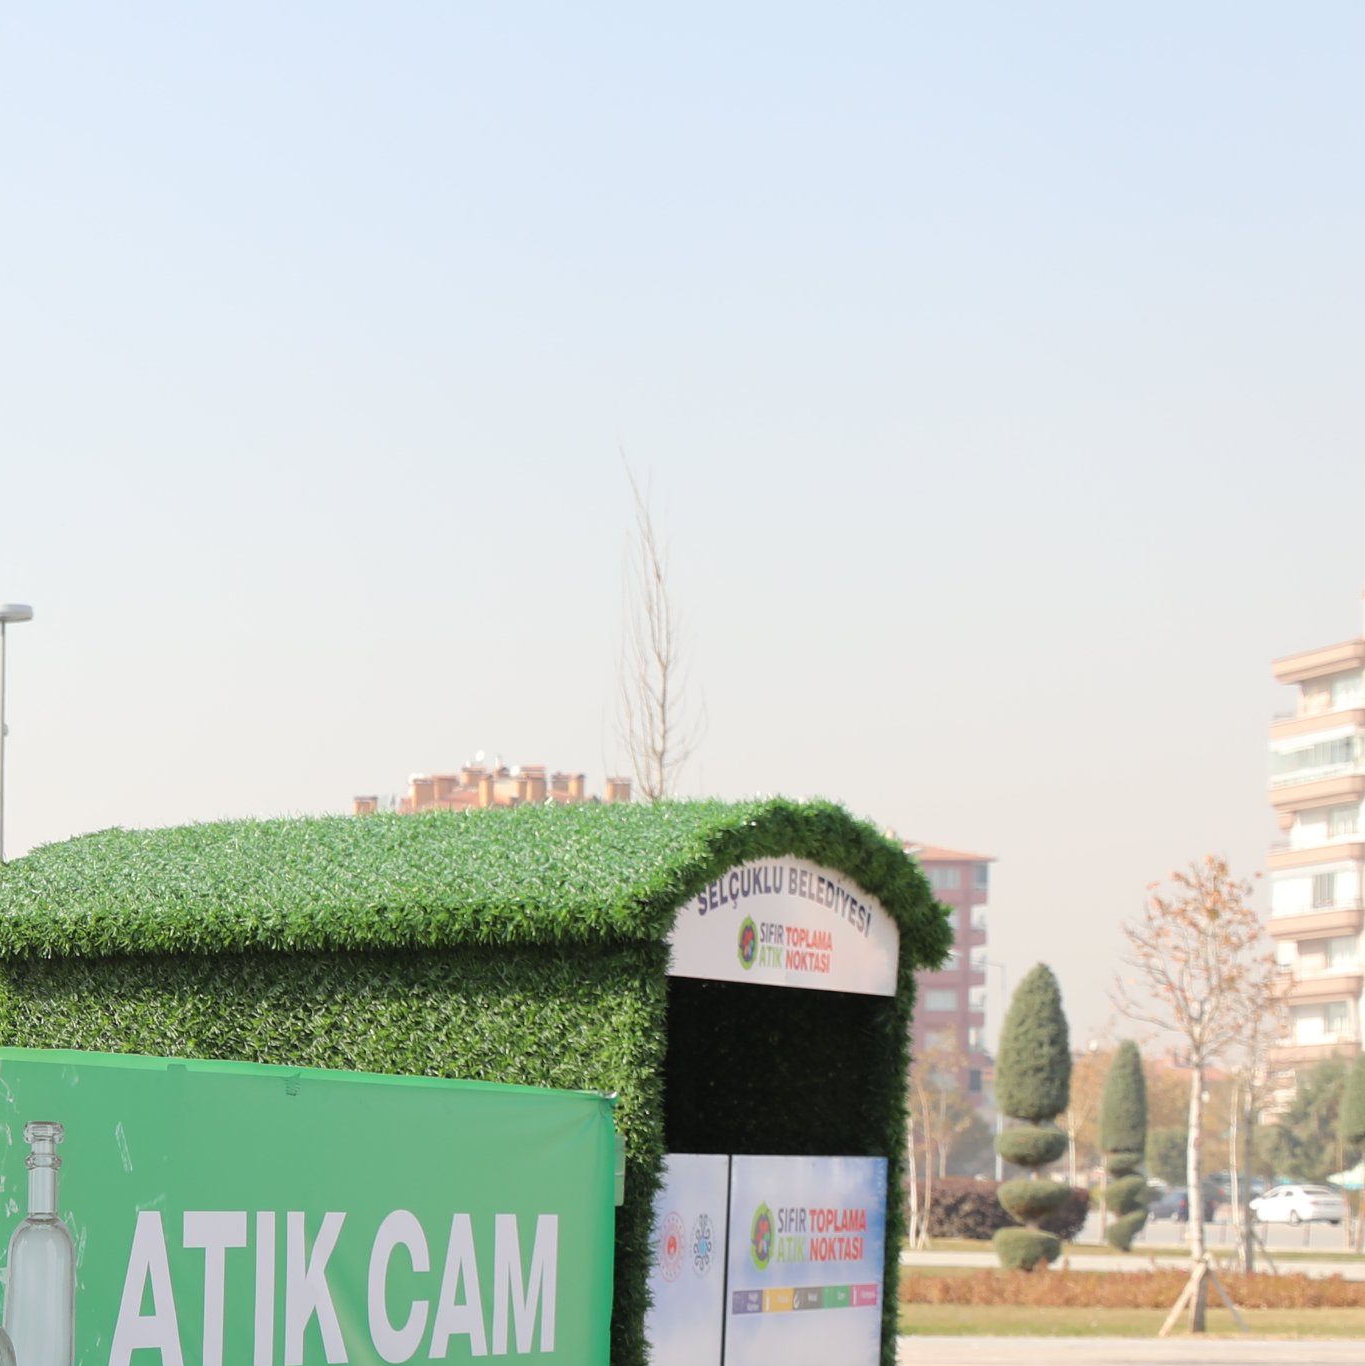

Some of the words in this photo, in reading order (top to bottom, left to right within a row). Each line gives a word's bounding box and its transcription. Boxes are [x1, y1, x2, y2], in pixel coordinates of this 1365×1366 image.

[698, 866, 783, 916] SELÇUKLU
[788, 867, 873, 938] BELEDİYESİ
[760, 922, 784, 944] SIFIR
[785, 926, 833, 951] TOPLAMA
[759, 945, 783, 968] ATIK
[785, 950, 830, 974] NOKTASI
[777, 1208, 806, 1233] SIFIR
[808, 1209, 866, 1233] TOPLAMA
[776, 1238, 806, 1263] ATIK
[809, 1237, 864, 1262] NOKTASI
[367, 1208, 559, 1364] CAM
